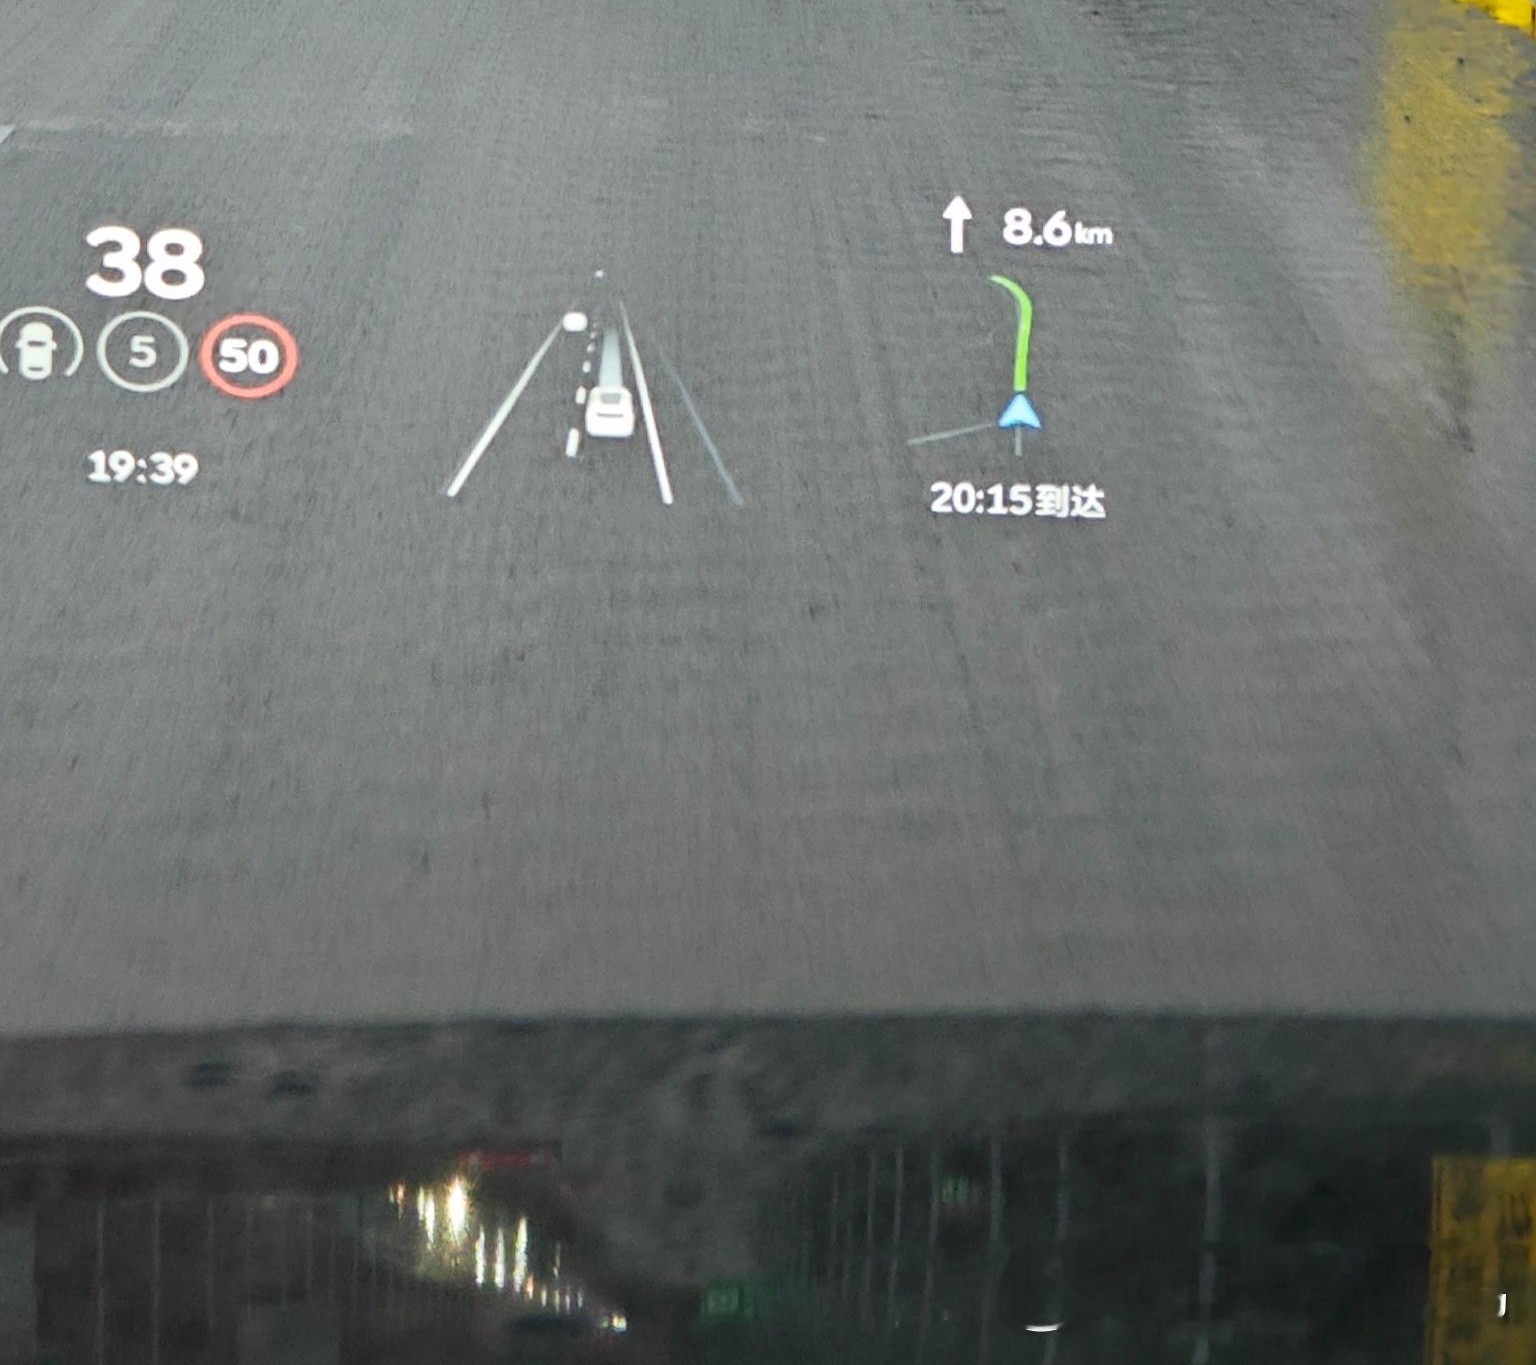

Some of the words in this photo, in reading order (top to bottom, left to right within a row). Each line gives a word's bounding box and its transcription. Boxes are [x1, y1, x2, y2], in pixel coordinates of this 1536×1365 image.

[85, 225, 205, 300] 38
[129, 335, 157, 368] 5
[218, 337, 280, 374] 50
[86, 449, 199, 485] 19:39
[930, 481, 1106, 519] 20:15到达
